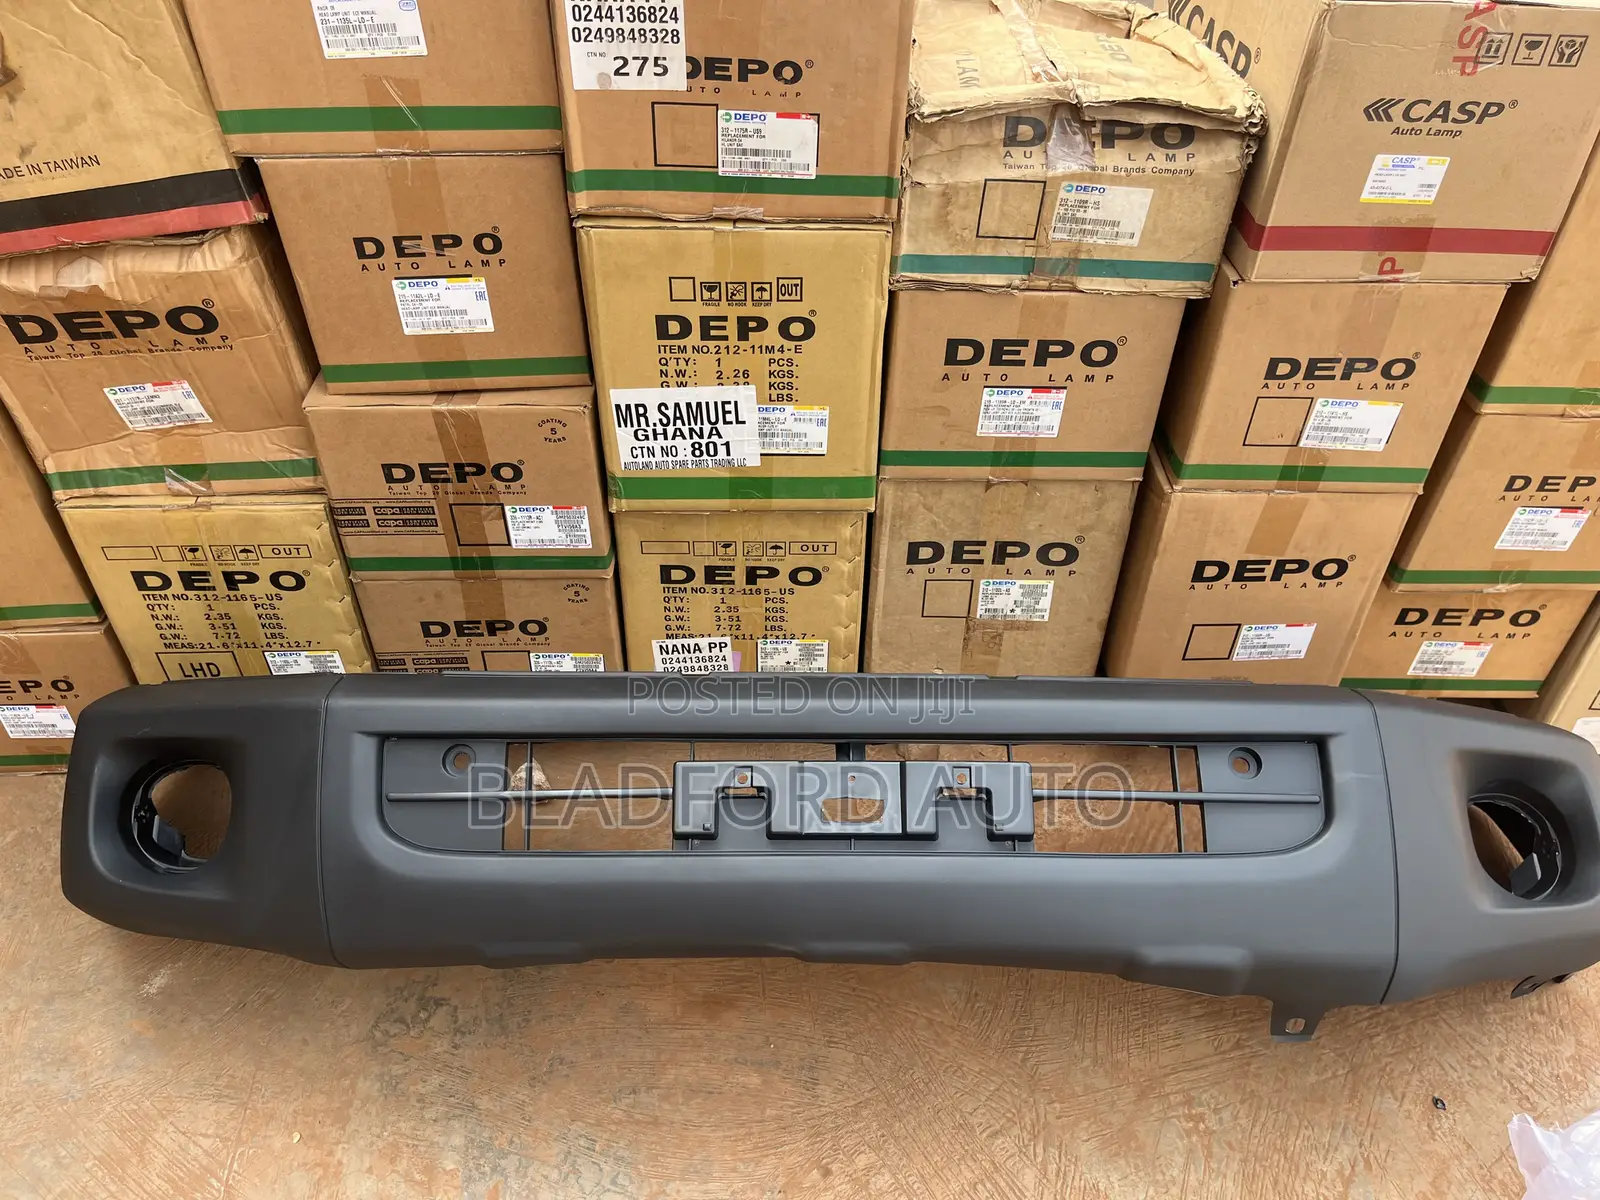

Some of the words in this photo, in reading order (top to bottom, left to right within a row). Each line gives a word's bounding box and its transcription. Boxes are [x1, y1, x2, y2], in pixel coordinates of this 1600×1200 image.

[571, 4, 679, 24] 0244136824
[571, 26, 680, 44] 0249848328
[613, 56, 668, 76] 275
[734, 113, 766, 121] DEPO
[1402, 99, 1505, 124] CASP
[1391, 126, 1422, 136] Auto
[1425, 127, 1463, 139] Lamp
[1128, 153, 1196, 162] LAMP
[26, 163, 42, 176] IN
[43, 154, 100, 172] TAIWAN
[1113, 166, 1146, 174] Brands
[1151, 167, 1195, 176] Company
[1075, 185, 1106, 194] DEPO
[353, 233, 502, 260] DEPO
[361, 262, 420, 272] AUTO
[448, 258, 506, 269] LAMP
[780, 284, 800, 297] OUT
[1, 306, 219, 344] DEPO
[655, 314, 816, 342] DEPO
[24, 342, 100, 355] AUTO
[149, 335, 229, 348] LAMP
[658, 345, 687, 354] ITEM
[27, 354, 63, 362] Taiwan
[189, 344, 234, 352] Company
[944, 338, 1118, 367] DEPO
[658, 357, 697, 367] Q'TY:
[715, 358, 722, 368] 1
[768, 357, 799, 368] PCS.
[660, 369, 698, 378] N.W.:
[716, 369, 750, 380] 2.26
[768, 370, 799, 379] KGS.
[1264, 358, 1416, 380] DEPO
[942, 373, 1008, 382] AUTO
[1049, 374, 1114, 382] LAMP
[768, 382, 799, 391] KGS.
[1261, 382, 1316, 391] AUTO
[1357, 382, 1410, 391] LAMP
[768, 394, 798, 402] LBS.
[614, 400, 746, 428] MR.SAMUEL
[538, 418, 568, 428] COATING
[634, 426, 723, 442] GHANA
[630, 446, 656, 459] CTN
[661, 445, 678, 458] NO
[690, 441, 732, 458] 801
[624, 460, 654, 470] AUTOLAND
[655, 460, 670, 470] AUTO
[671, 460, 690, 469] SPARE
[691, 459, 709, 468] PARTS
[711, 458, 736, 468] TRADING
[737, 458, 746, 467] LLC
[380, 462, 524, 484] DEPO
[375, 507, 400, 515] capa
[272, 547, 302, 556] OUT
[800, 544, 829, 552] OUT
[906, 540, 1080, 567] DEPO
[660, 564, 822, 587] DEPO
[1006, 568, 1076, 576] LAMP
[1190, 558, 1348, 582] DEPO
[130, 570, 306, 592] DEPO
[563, 583, 590, 591] COATING
[1284, 581, 1344, 589] LAMP
[142, 594, 170, 602] ITEM
[663, 596, 690, 604] Q'TY:
[147, 604, 175, 612] Q'TY:
[254, 603, 280, 611] PCS.
[204, 613, 232, 621] 2.35
[258, 613, 284, 621] KGS.
[1394, 608, 1541, 628] DEPO
[155, 623, 184, 631] G.W.:
[261, 622, 287, 630] KGS.
[420, 619, 548, 638] DEPO
[765, 624, 786, 632] LBS.
[264, 632, 288, 640] LBS.
[659, 642, 702, 656] NANA
[708, 642, 728, 654] PP
[662, 654, 727, 665] 0244136824
[178, 662, 221, 678] LHD
